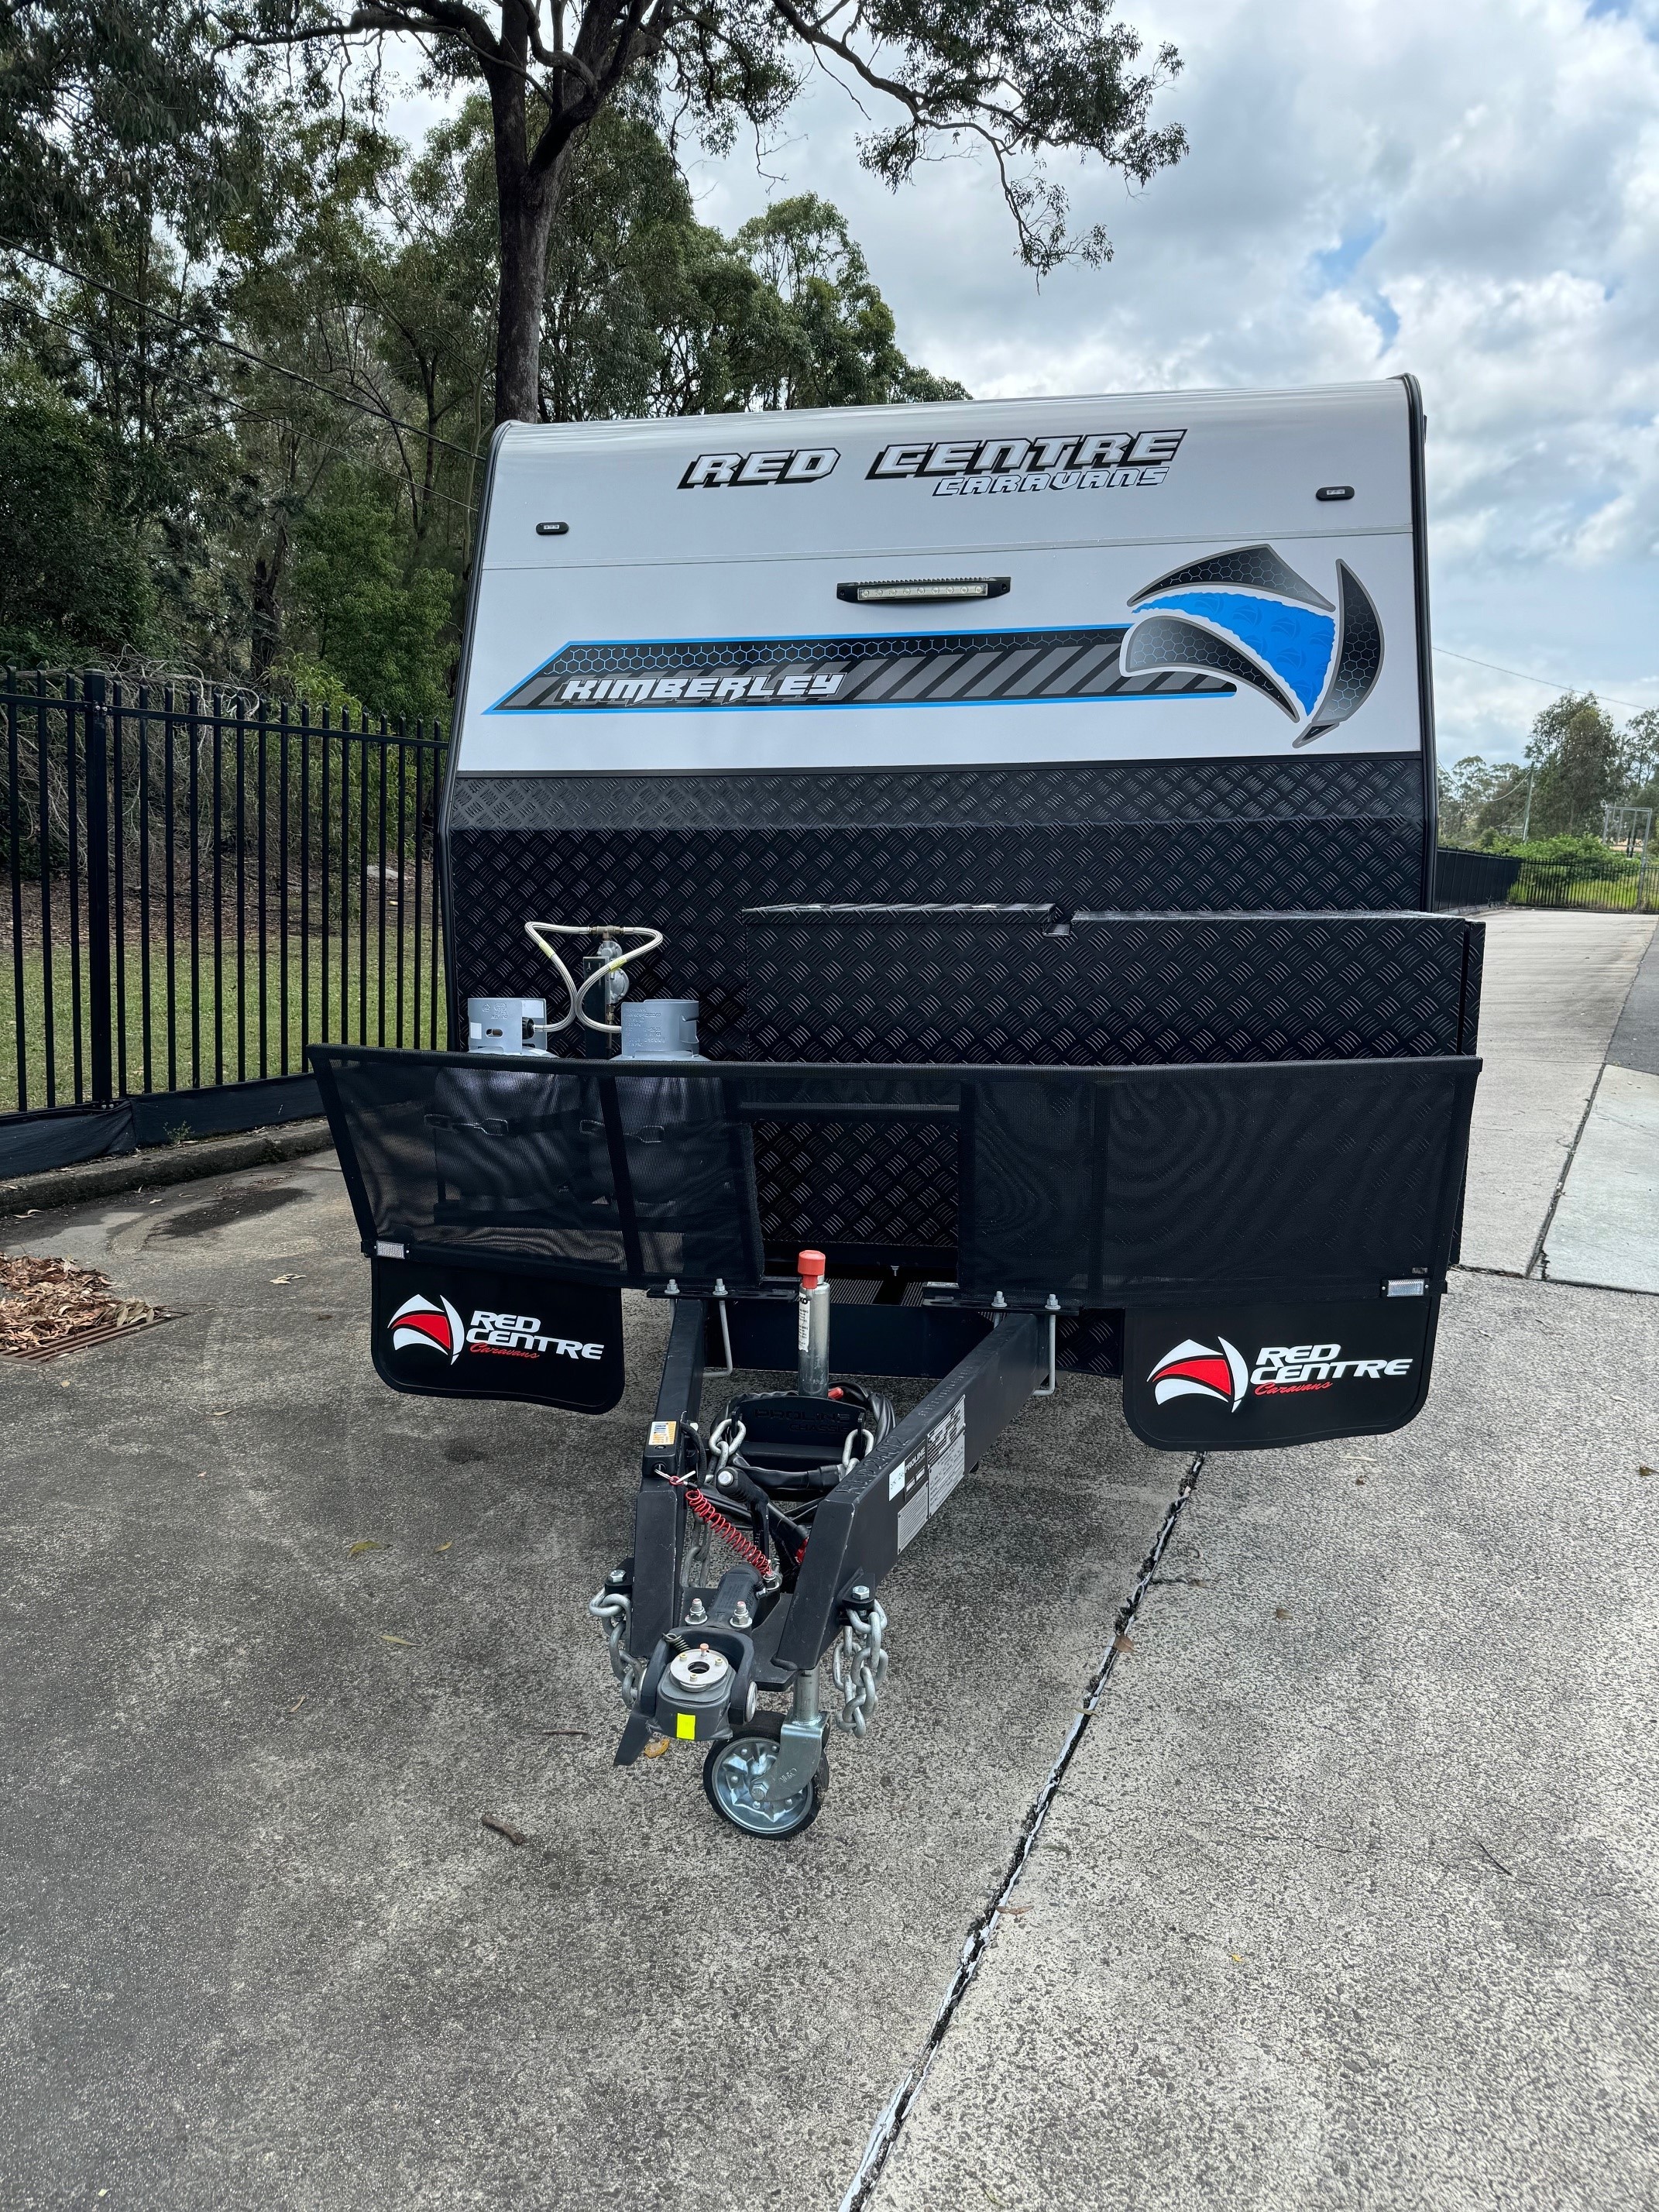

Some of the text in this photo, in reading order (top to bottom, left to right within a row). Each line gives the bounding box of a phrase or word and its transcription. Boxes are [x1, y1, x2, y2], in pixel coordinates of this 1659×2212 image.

[677, 428, 1187, 489] RED CENTRE
[932, 466, 1170, 496] CARAVANS
[558, 672, 848, 706] KIMBERLEY
[470, 1310, 541, 1333] RED
[465, 1328, 605, 1360] CENTRE
[469, 1342, 540, 1358] Caravans
[1255, 1343, 1341, 1368] RED
[1250, 1358, 1413, 1385] CENTRE
[1254, 1382, 1333, 1396] Caravans
[905, 1446, 926, 1474] PROLINE
